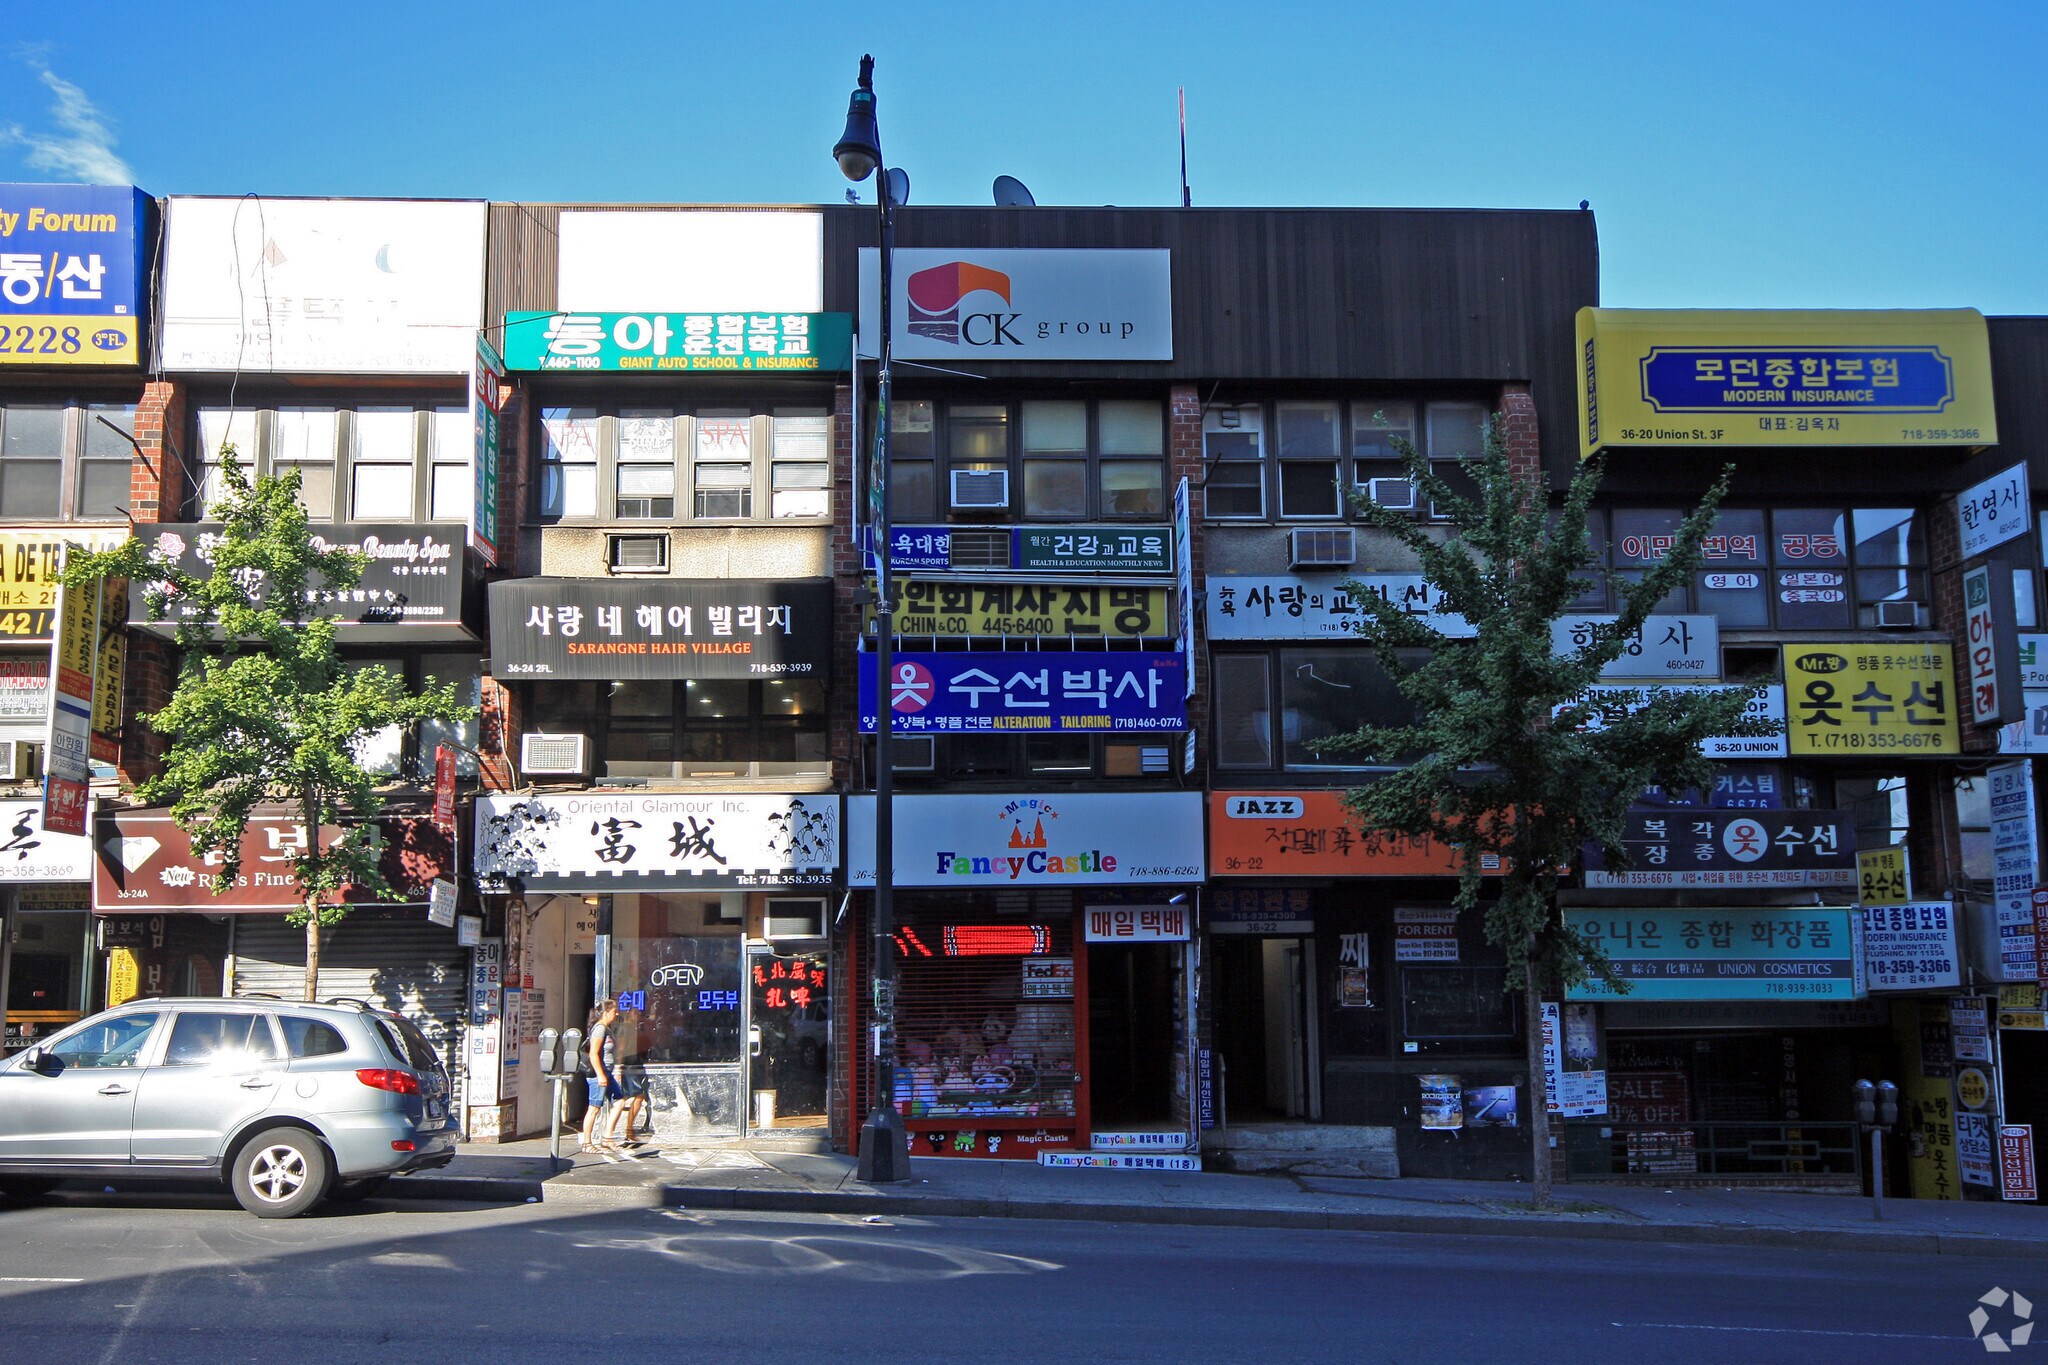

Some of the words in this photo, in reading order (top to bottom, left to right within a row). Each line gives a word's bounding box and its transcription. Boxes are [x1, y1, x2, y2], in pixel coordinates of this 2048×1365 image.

[27, 208, 117, 232] Forum
[684, 315, 809, 336] 종합보험
[962, 313, 1025, 346] CK
[1037, 322, 1134, 339] group
[543, 316, 674, 355] 동아
[684, 336, 811, 355] 운전학교
[619, 357, 653, 368] GIANT
[657, 357, 689, 368] AUTO
[692, 357, 738, 368] SCHOOL
[742, 358, 752, 368] &
[756, 357, 819, 368] INSURANCE
[1695, 358, 1899, 388] 모던종합보험
[1723, 390, 1785, 402] MODERN
[1792, 390, 1875, 402] INSURANCE
[702, 420, 748, 447] SPA
[1621, 429, 1653, 439] 36-20
[1655, 429, 1690, 439] Union
[1692, 429, 1708, 439] St.
[1709, 429, 1724, 439] 3F
[1902, 428, 1980, 440] 718-359-3366
[1961, 481, 2020, 530] 한영사
[362, 535, 418, 563] Beauty
[419, 536, 451, 563] Spa
[1782, 535, 1839, 558] 공증
[15, 543, 37, 582] DE
[921, 557, 949, 566] SPORTS
[1030, 559, 1058, 567] HEALTH
[1066, 559, 1107, 567] EDUCATION
[1108, 559, 1142, 567] MONTHLY
[1143, 559, 1164, 567] NEWS
[1711, 575, 1753, 588] 영어
[1785, 574, 1837, 585] 일본어
[526, 606, 584, 636] 사랑
[598, 606, 623, 635] 네
[635, 606, 693, 635] 헤어
[708, 606, 792, 635] 빌리지
[901, 617, 936, 633] CHIN
[568, 643, 647, 654] SARANGNE
[651, 643, 686, 654] HAIR
[691, 642, 751, 654] VILLAGE
[507, 664, 534, 673] 36-24
[751, 663, 812, 673] 718-539-3939
[1666, 659, 1705, 670] 460-0427
[1799, 680, 1946, 726] 옷수선
[965, 716, 993, 729] 전문
[993, 715, 1051, 729] ALTERATION
[1060, 715, 1112, 729] TAILORING
[1715, 743, 1742, 752] 36-20
[1745, 742, 1779, 752] UNION
[1716, 774, 1775, 794] 커스텀
[567, 799, 634, 814] Oriental
[642, 799, 713, 814] Glamour
[722, 799, 751, 814] Inc.
[1004, 798, 1053, 815] Magic
[1236, 801, 1296, 815] JAZZ
[590, 815, 727, 865] 富城
[1225, 857, 1264, 870] 36-22
[165, 868, 191, 884] New
[254, 872, 295, 887] Fine
[1129, 866, 1200, 877] 718-886-6263
[736, 875, 758, 885] Tel:
[759, 875, 833, 885] 718.358.3935
[117, 889, 149, 899] 36-24A
[1397, 925, 1422, 936] FOR
[1423, 925, 1456, 936] RENT
[1679, 920, 1734, 949] 종합
[1750, 919, 1833, 949] 화장품
[1865, 932, 1896, 942] ODERN
[1899, 932, 1948, 942] INSURANCE
[1718, 963, 1756, 975] UNION
[1762, 963, 1832, 975] COSMETICS
[1867, 960, 1951, 974] 18-359-3366
[651, 963, 703, 987] OPEN
[1766, 982, 1833, 994] 718-939-3033
[618, 989, 645, 1011] 순대
[699, 990, 739, 1011] 모두부
[1608, 1079, 1664, 1099] SALE
[1643, 1105, 1682, 1122] OFF
[1017, 1134, 1045, 1143] Magic
[1047, 1134, 1069, 1143] Castle
